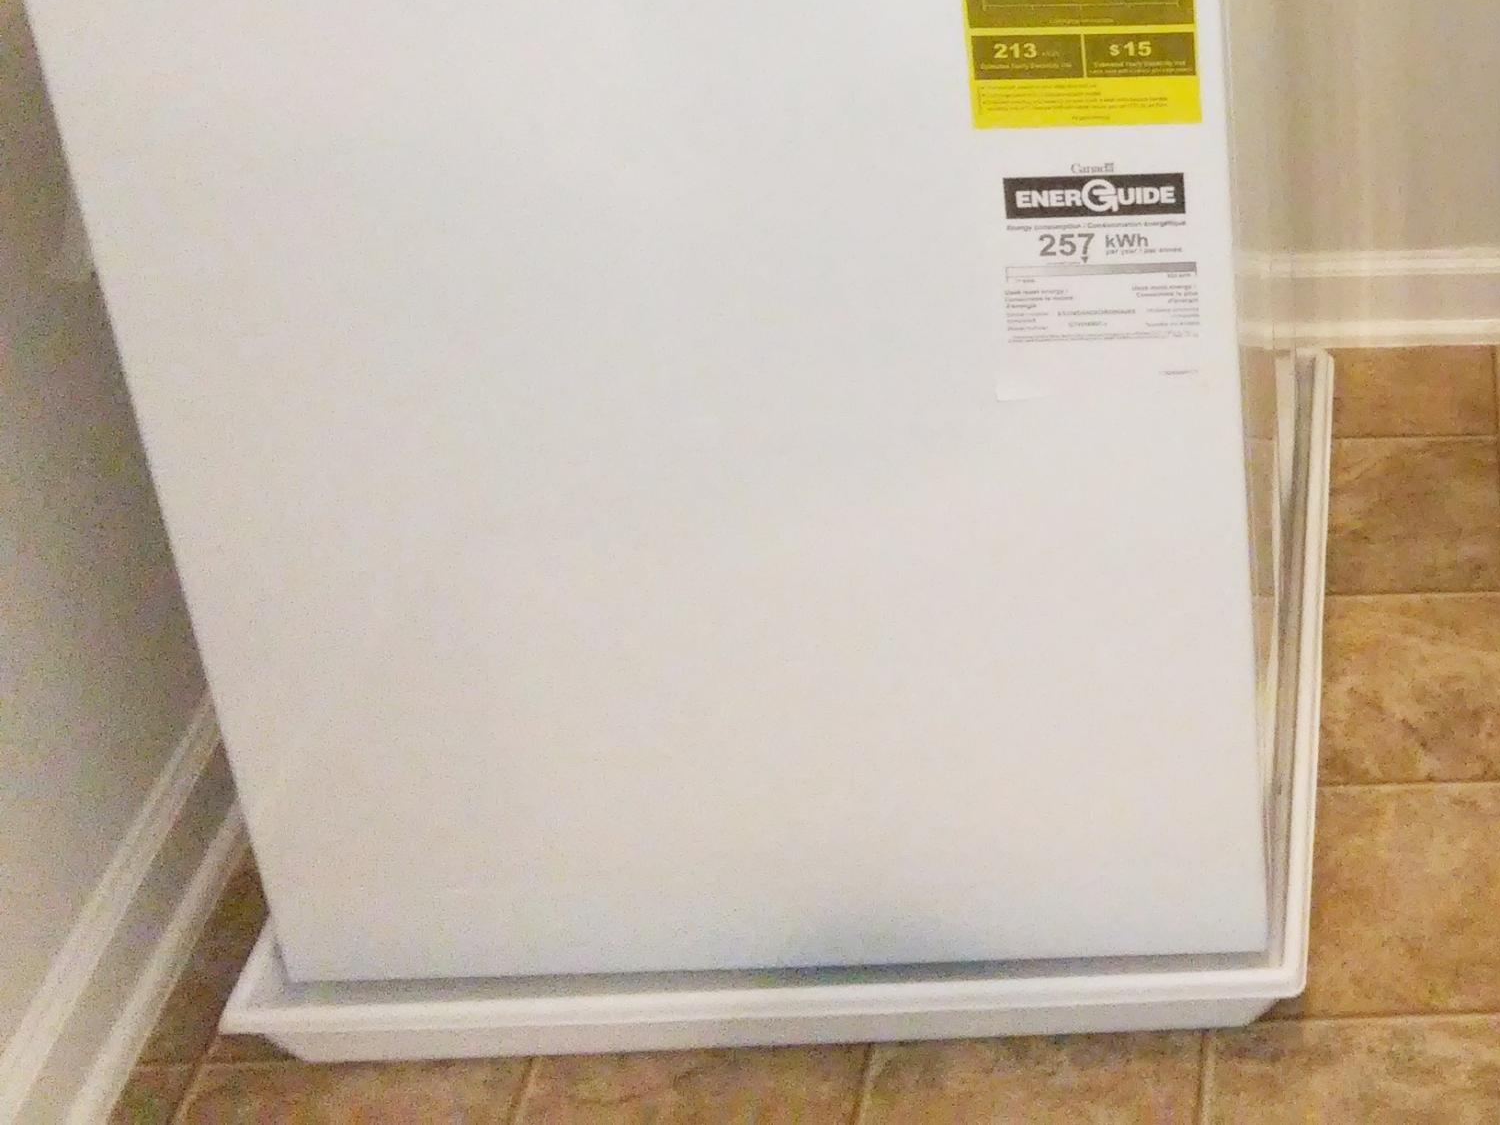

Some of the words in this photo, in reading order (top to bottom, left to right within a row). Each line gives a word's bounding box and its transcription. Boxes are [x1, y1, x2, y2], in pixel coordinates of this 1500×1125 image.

[993, 42, 1039, 60] 213
[1109, 40, 1152, 58] $15
[1014, 178, 1177, 213] ENERGUIDE
[1038, 232, 1095, 257] 257
[1104, 232, 1149, 248] kWh
